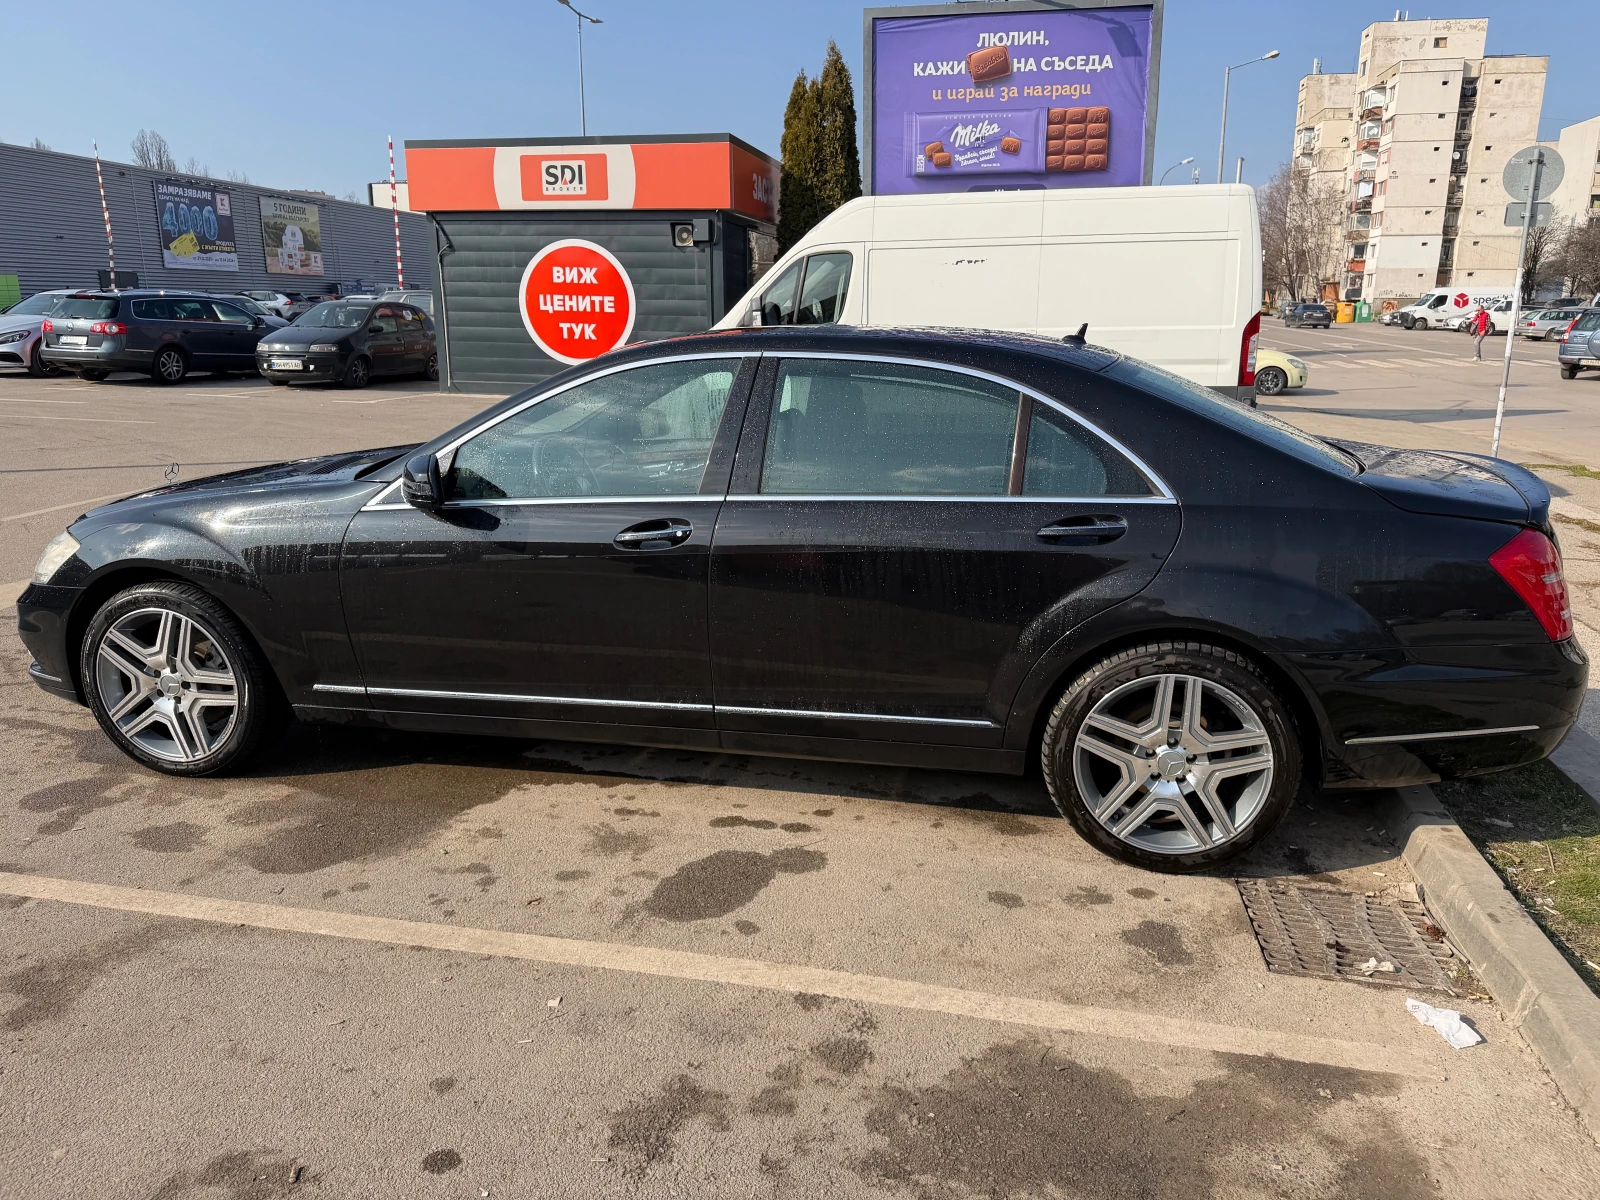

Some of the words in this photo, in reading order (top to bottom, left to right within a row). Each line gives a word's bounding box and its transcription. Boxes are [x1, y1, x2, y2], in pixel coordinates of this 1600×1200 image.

[977, 30, 1049, 47] ЛЮЛИН,
[913, 60, 966, 76] КАЖИ
[1013, 57, 1037, 72] НА
[1041, 55, 1113, 73] СЪСЕДА
[932, 89, 942, 100] и
[947, 84, 995, 103] играй
[1000, 87, 1018, 102] за
[1023, 83, 1092, 99] награди
[950, 119, 1001, 148] Milka
[545, 164, 584, 186] SDI
[157, 184, 213, 201] ЗАМРАЗЯВАМЕ
[273, 202, 278, 212] 5
[279, 203, 307, 216] ГОДИНИ
[163, 201, 219, 241] 4000
[552, 266, 598, 284] ВИЖ
[538, 293, 615, 314] ЦЕНИТЕ
[558, 322, 597, 340] ТУК
